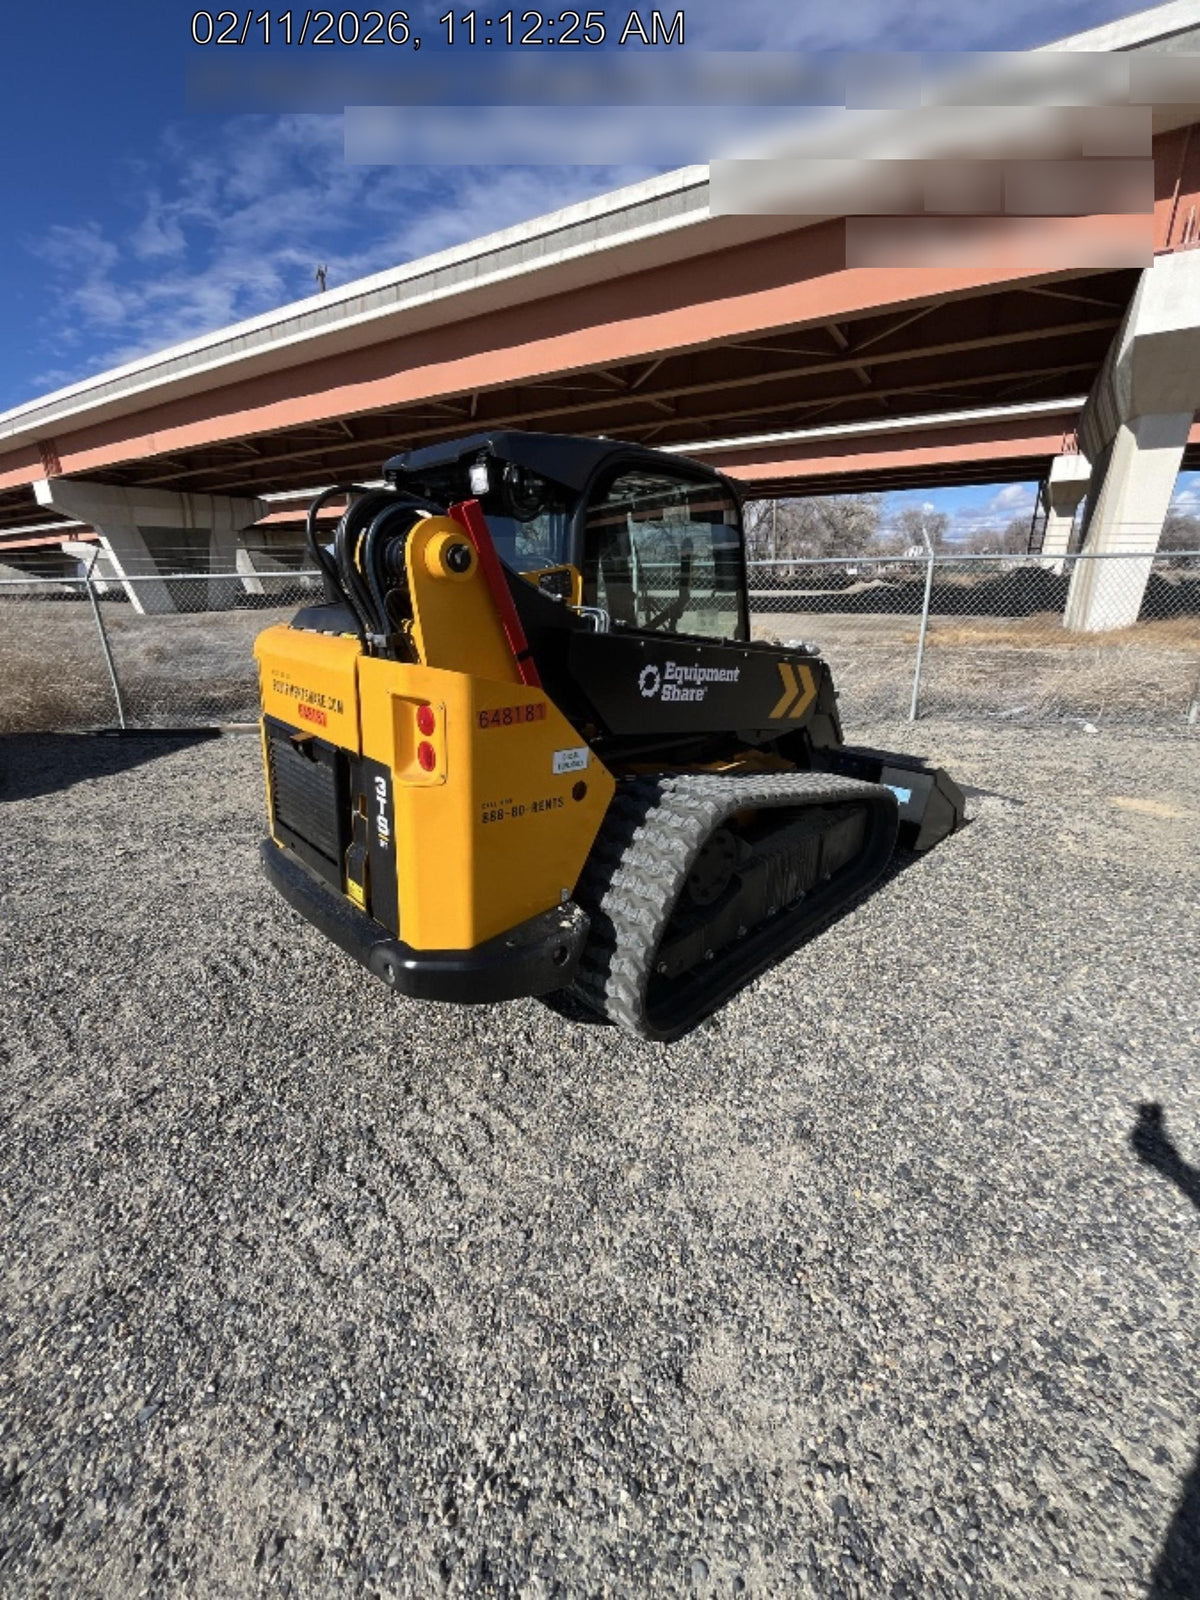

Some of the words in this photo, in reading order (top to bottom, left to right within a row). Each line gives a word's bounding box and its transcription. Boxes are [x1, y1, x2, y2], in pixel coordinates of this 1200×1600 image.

[664, 661, 740, 685] Equipment
[478, 703, 545, 729] 648181
[481, 797, 564, 824] 888-80-RENTS
